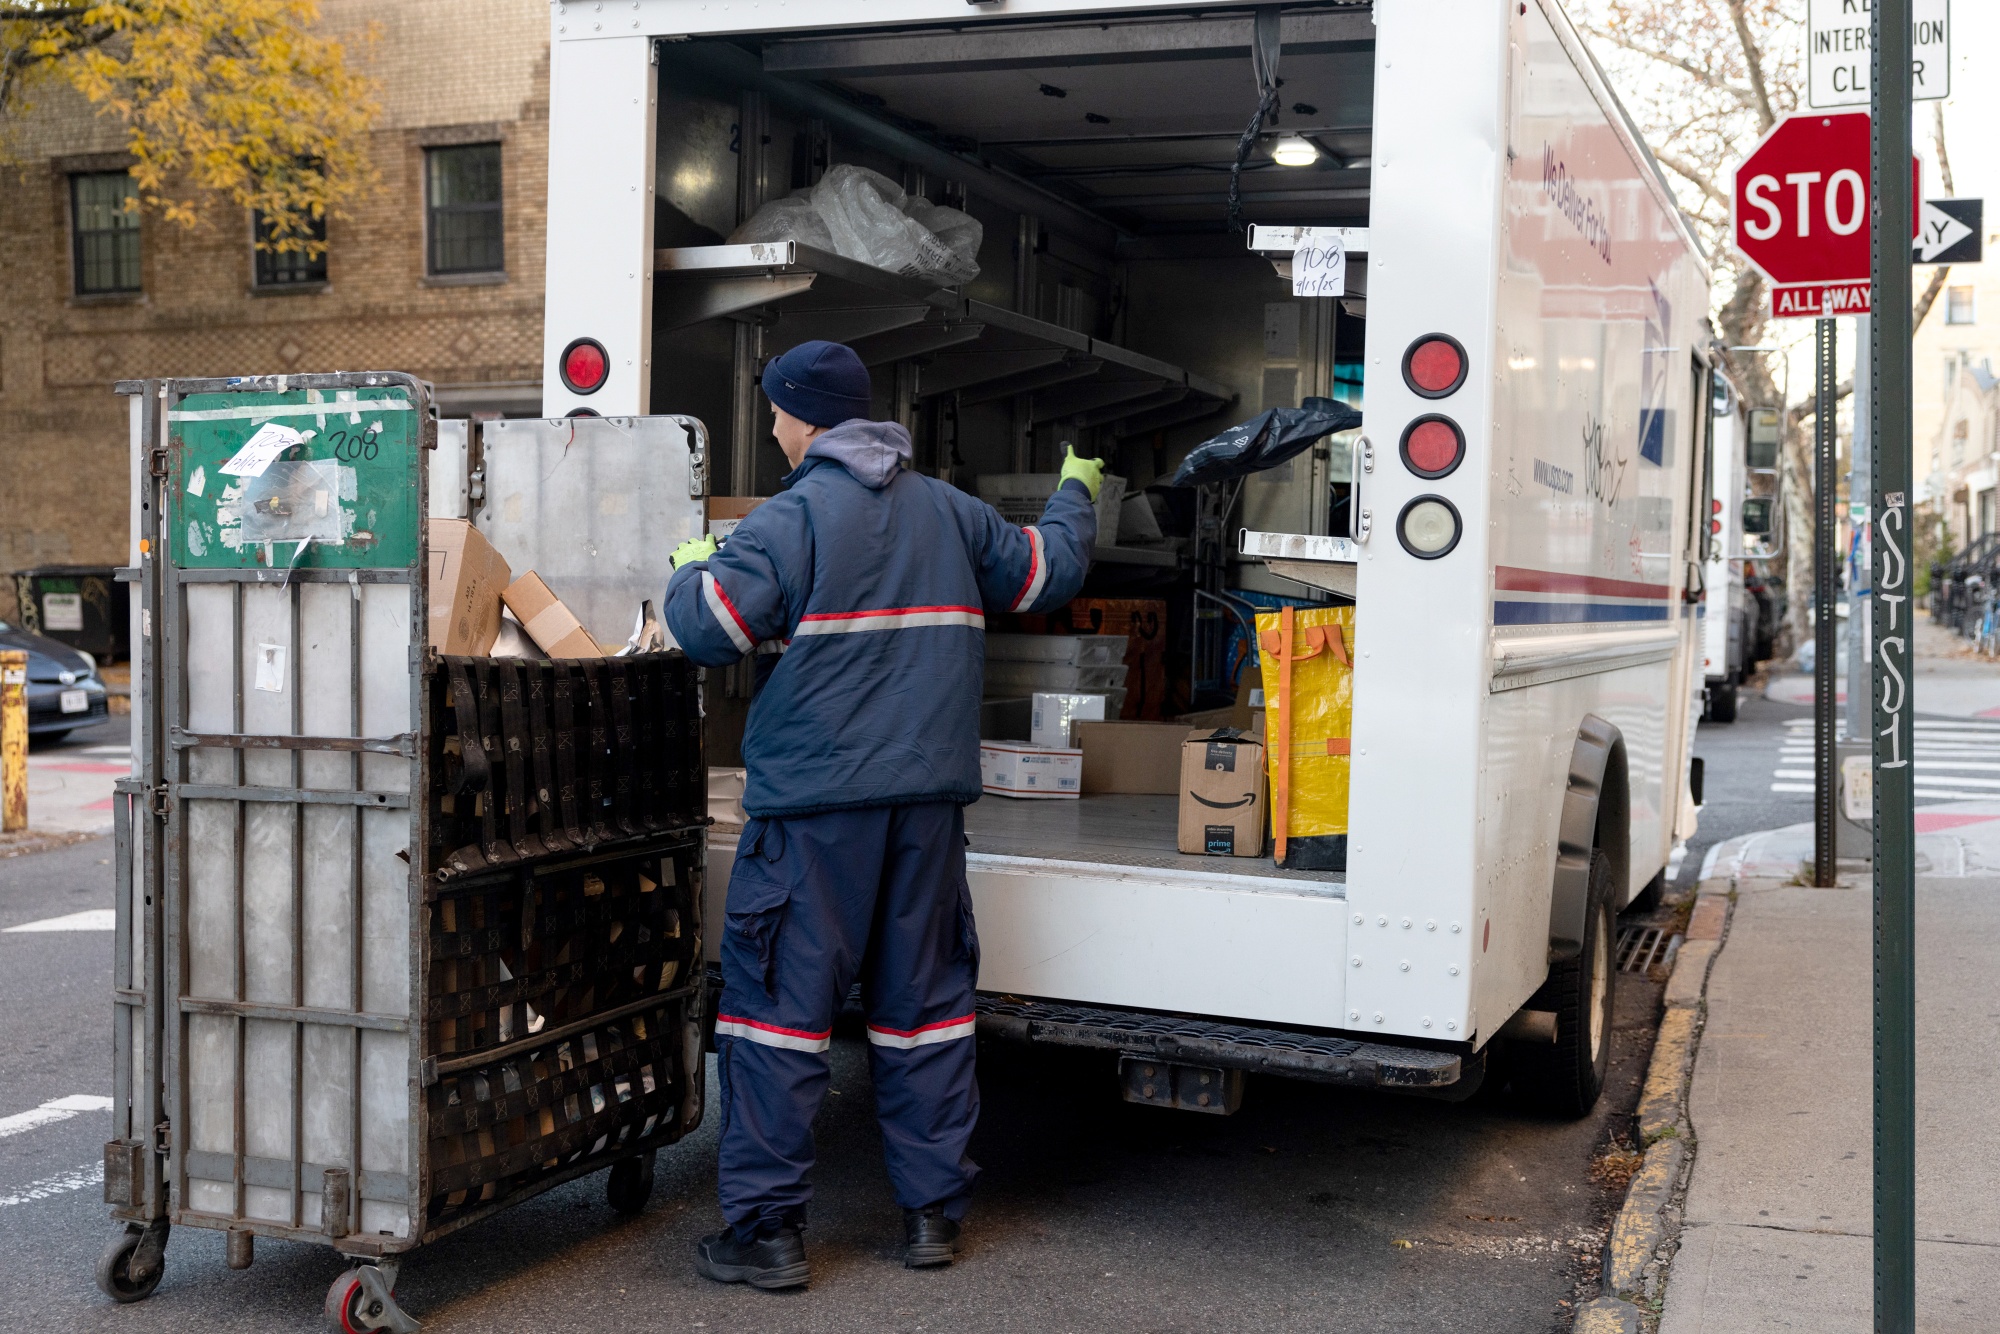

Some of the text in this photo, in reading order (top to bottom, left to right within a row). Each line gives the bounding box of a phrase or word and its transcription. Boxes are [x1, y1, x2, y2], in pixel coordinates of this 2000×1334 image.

[1833, 60, 1925, 92] CLR
[1543, 139, 1557, 202] We
[1557, 160, 1586, 234] Deliver
[1585, 196, 1599, 250] For
[1743, 168, 1866, 241] STO
[1778, 286, 1871, 313] ALL WAY
[328, 427, 379, 463] 208
[1208, 839, 1231, 849] prime
